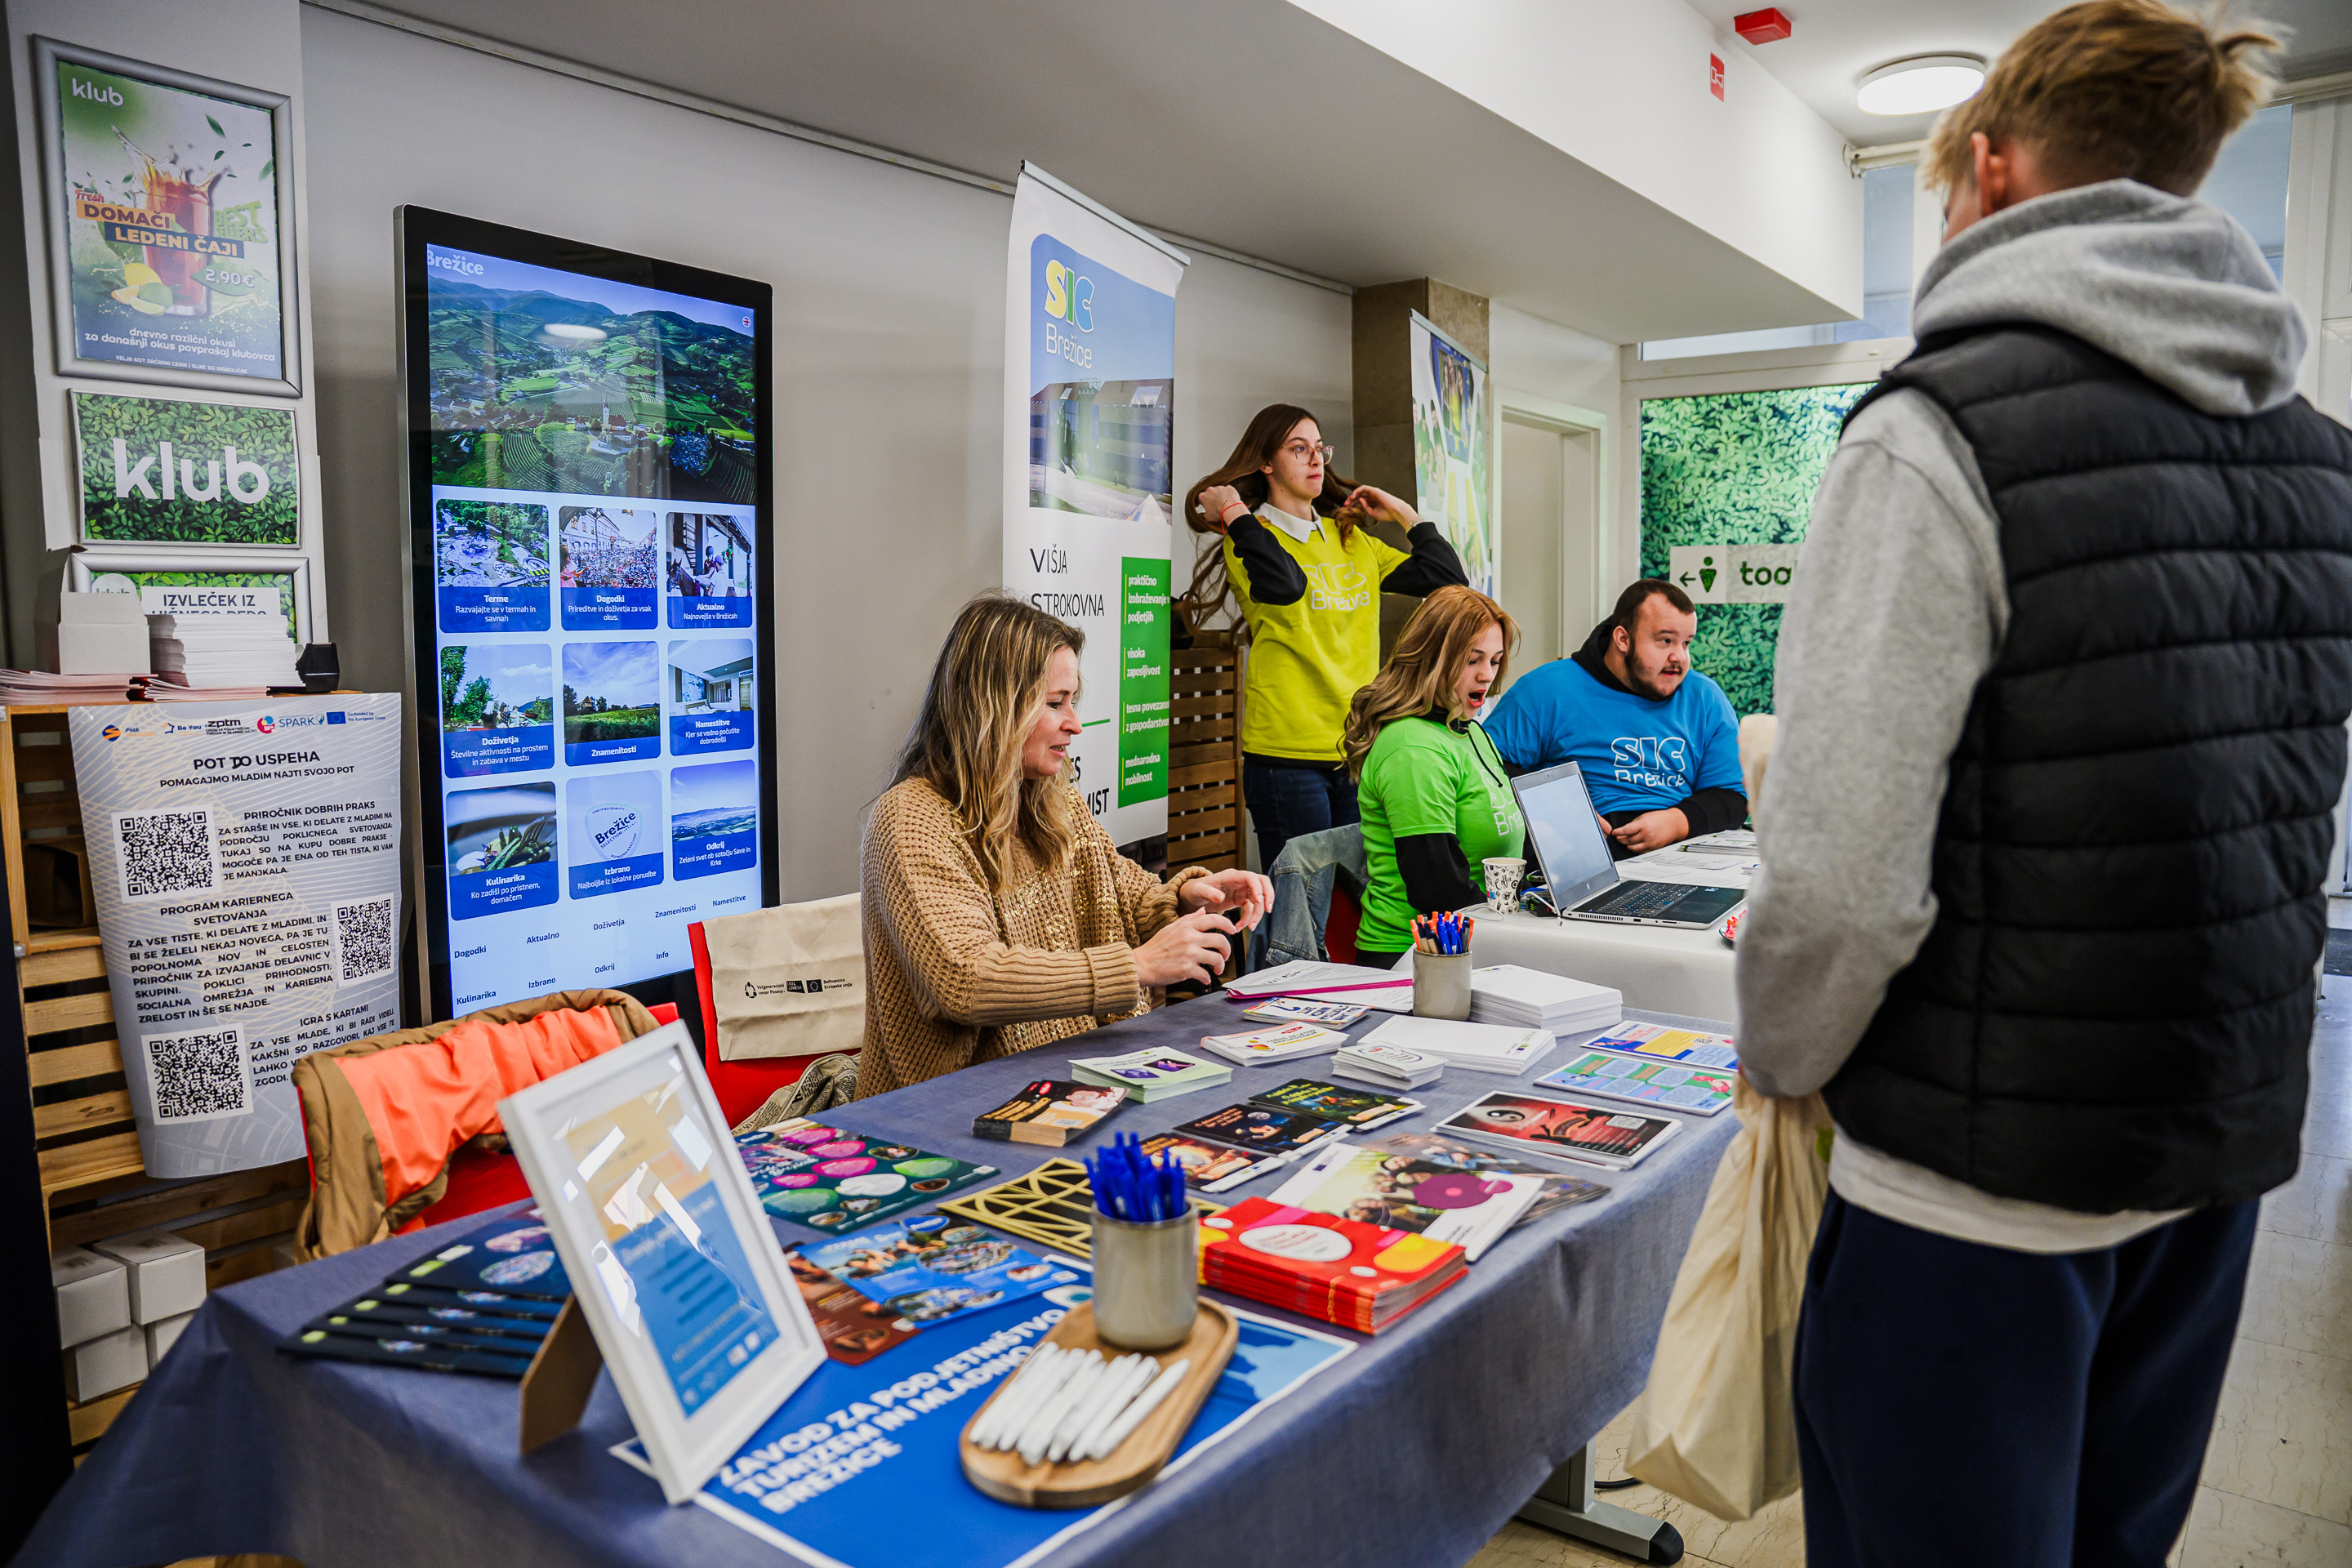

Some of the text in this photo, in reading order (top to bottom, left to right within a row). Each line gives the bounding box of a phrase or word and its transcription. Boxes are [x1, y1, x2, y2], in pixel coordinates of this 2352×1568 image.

[73, 78, 124, 107] klub
[75, 189, 105, 203] Fresh
[84, 203, 172, 229] DOMAČI
[214, 201, 263, 227] BEST
[115, 227, 237, 256] LEDENI ČAJI
[427, 249, 483, 276] Brežice
[206, 268, 255, 287] 2,90€
[1045, 260, 1094, 332] SIC
[129, 327, 235, 348] dnevno različni okusi
[1046, 322, 1092, 369] Brežice
[85, 332, 275, 361] za današnji okus povprašaj klubovca
[113, 438, 270, 504] klub
[1030, 543, 1067, 574] VIŠJA
[1129, 574, 1156, 587] praktično
[1740, 560, 1797, 586] toa
[163, 592, 256, 607] IZVLEČEK IZ
[483, 595, 509, 603] Terme
[596, 595, 625, 604] Dogodki
[1031, 592, 1105, 617] STROKOVNA
[1129, 593, 1166, 606] izobraževanje
[455, 606, 490, 614] Razvajajte
[1128, 611, 1153, 624] podjetjih
[1127, 647, 1145, 658] visoka
[1127, 665, 1160, 679] zaposljivost
[1126, 704, 1141, 713] tesna
[207, 719, 241, 728] zptm
[279, 717, 314, 728] SPARK
[695, 719, 730, 728] Namestitve
[1126, 724, 1129, 732] z
[482, 735, 519, 746] Doživetja
[700, 737, 726, 745] dobrodošli
[719, 728, 740, 737] počutite
[451, 750, 478, 759] Številne
[479, 746, 511, 756] aktivnosti
[522, 745, 549, 753] prostem
[591, 746, 637, 756] Znamenitosti
[1611, 737, 1686, 772] SIC
[194, 757, 226, 770] POT
[256, 751, 320, 765] USPEHA
[480, 757, 503, 765] zabava
[1125, 753, 1160, 768] mednarodna
[160, 775, 229, 787] POMAGAJMO
[232, 772, 272, 782] MLADIM
[274, 769, 301, 778] NAJTI
[304, 767, 335, 776] SVOJO
[1125, 771, 1152, 786] mobilnost
[244, 801, 375, 821] PRIROČNIK DOBRIH PRAKS
[595, 812, 636, 844] Brežice
[706, 841, 724, 850] Odkrij
[679, 856, 695, 864] Zeleni
[715, 849, 733, 858] sotočju
[605, 866, 630, 875] Izbrano
[486, 874, 525, 886] Kulinarika
[577, 880, 604, 889] Najboljše
[612, 875, 631, 884] lokalne
[633, 871, 657, 881] ponudbe
[481, 888, 500, 898] zadiši
[510, 883, 540, 893] pristnem,
[160, 892, 294, 915] PROGRAM KARIERNEGA
[491, 894, 522, 905] domačem
[194, 910, 267, 926] SVETOVANJA
[454, 894, 746, 960] Dogodki Aktualno Doživetja Znamenitosti Namestitve
[131, 940, 329, 973] POPOLNOMA NOV IN CELOSTEN
[133, 972, 193, 986] PRIROČNIK
[216, 960, 271, 975] IZVAJANJE
[274, 952, 321, 965] DELAVNIC
[457, 950, 670, 1005] Kulinarika Izbrano Odkrij Info
[137, 976, 333, 1010] SOCIALNA OMREŽJA IN KARIERNA
[139, 1012, 185, 1023] ZRELOST
[203, 1005, 216, 1015] ŠE
[234, 998, 270, 1010] NAJDE.
[300, 1015, 324, 1027] IGRA
[333, 1004, 368, 1020] KARTAMI
[719, 1421, 834, 1488] ZAVOD
[826, 1401, 881, 1430] ZA
[734, 1421, 883, 1499] TURIZEM
[871, 1404, 918, 1432] IN
